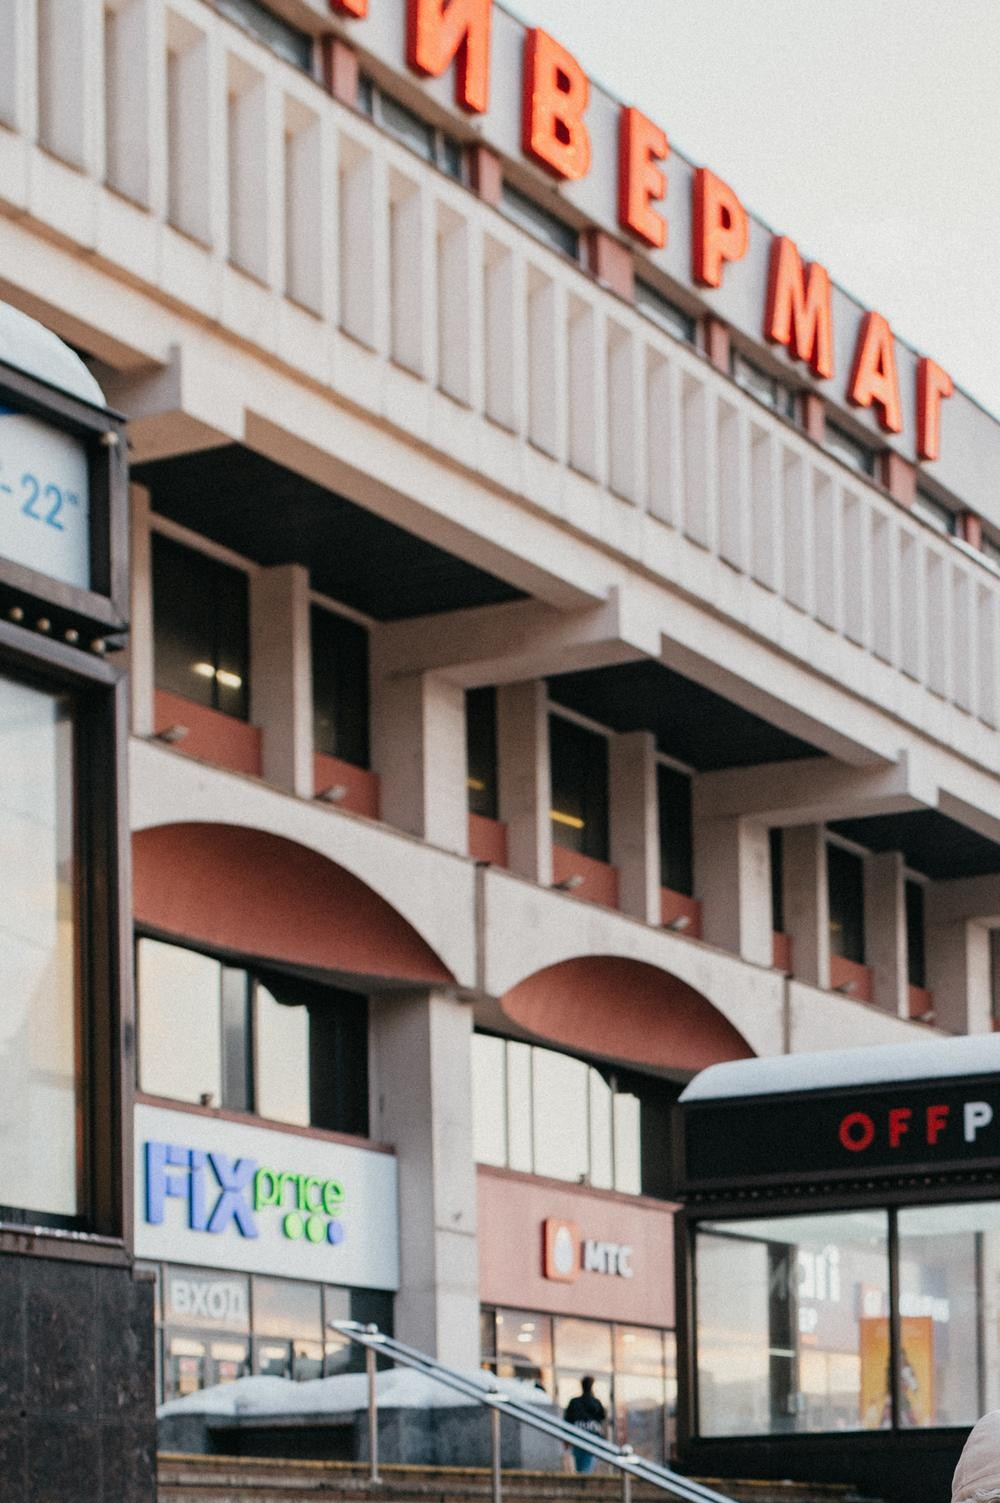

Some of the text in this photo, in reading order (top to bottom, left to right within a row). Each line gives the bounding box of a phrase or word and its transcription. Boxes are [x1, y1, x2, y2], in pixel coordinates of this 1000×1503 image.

[328, 0, 954, 461] ИВЕРМАГ
[144, 1141, 345, 1238] FIX price
[582, 1239, 634, 1279] МТС
[170, 1279, 248, 1321] ВХОД
